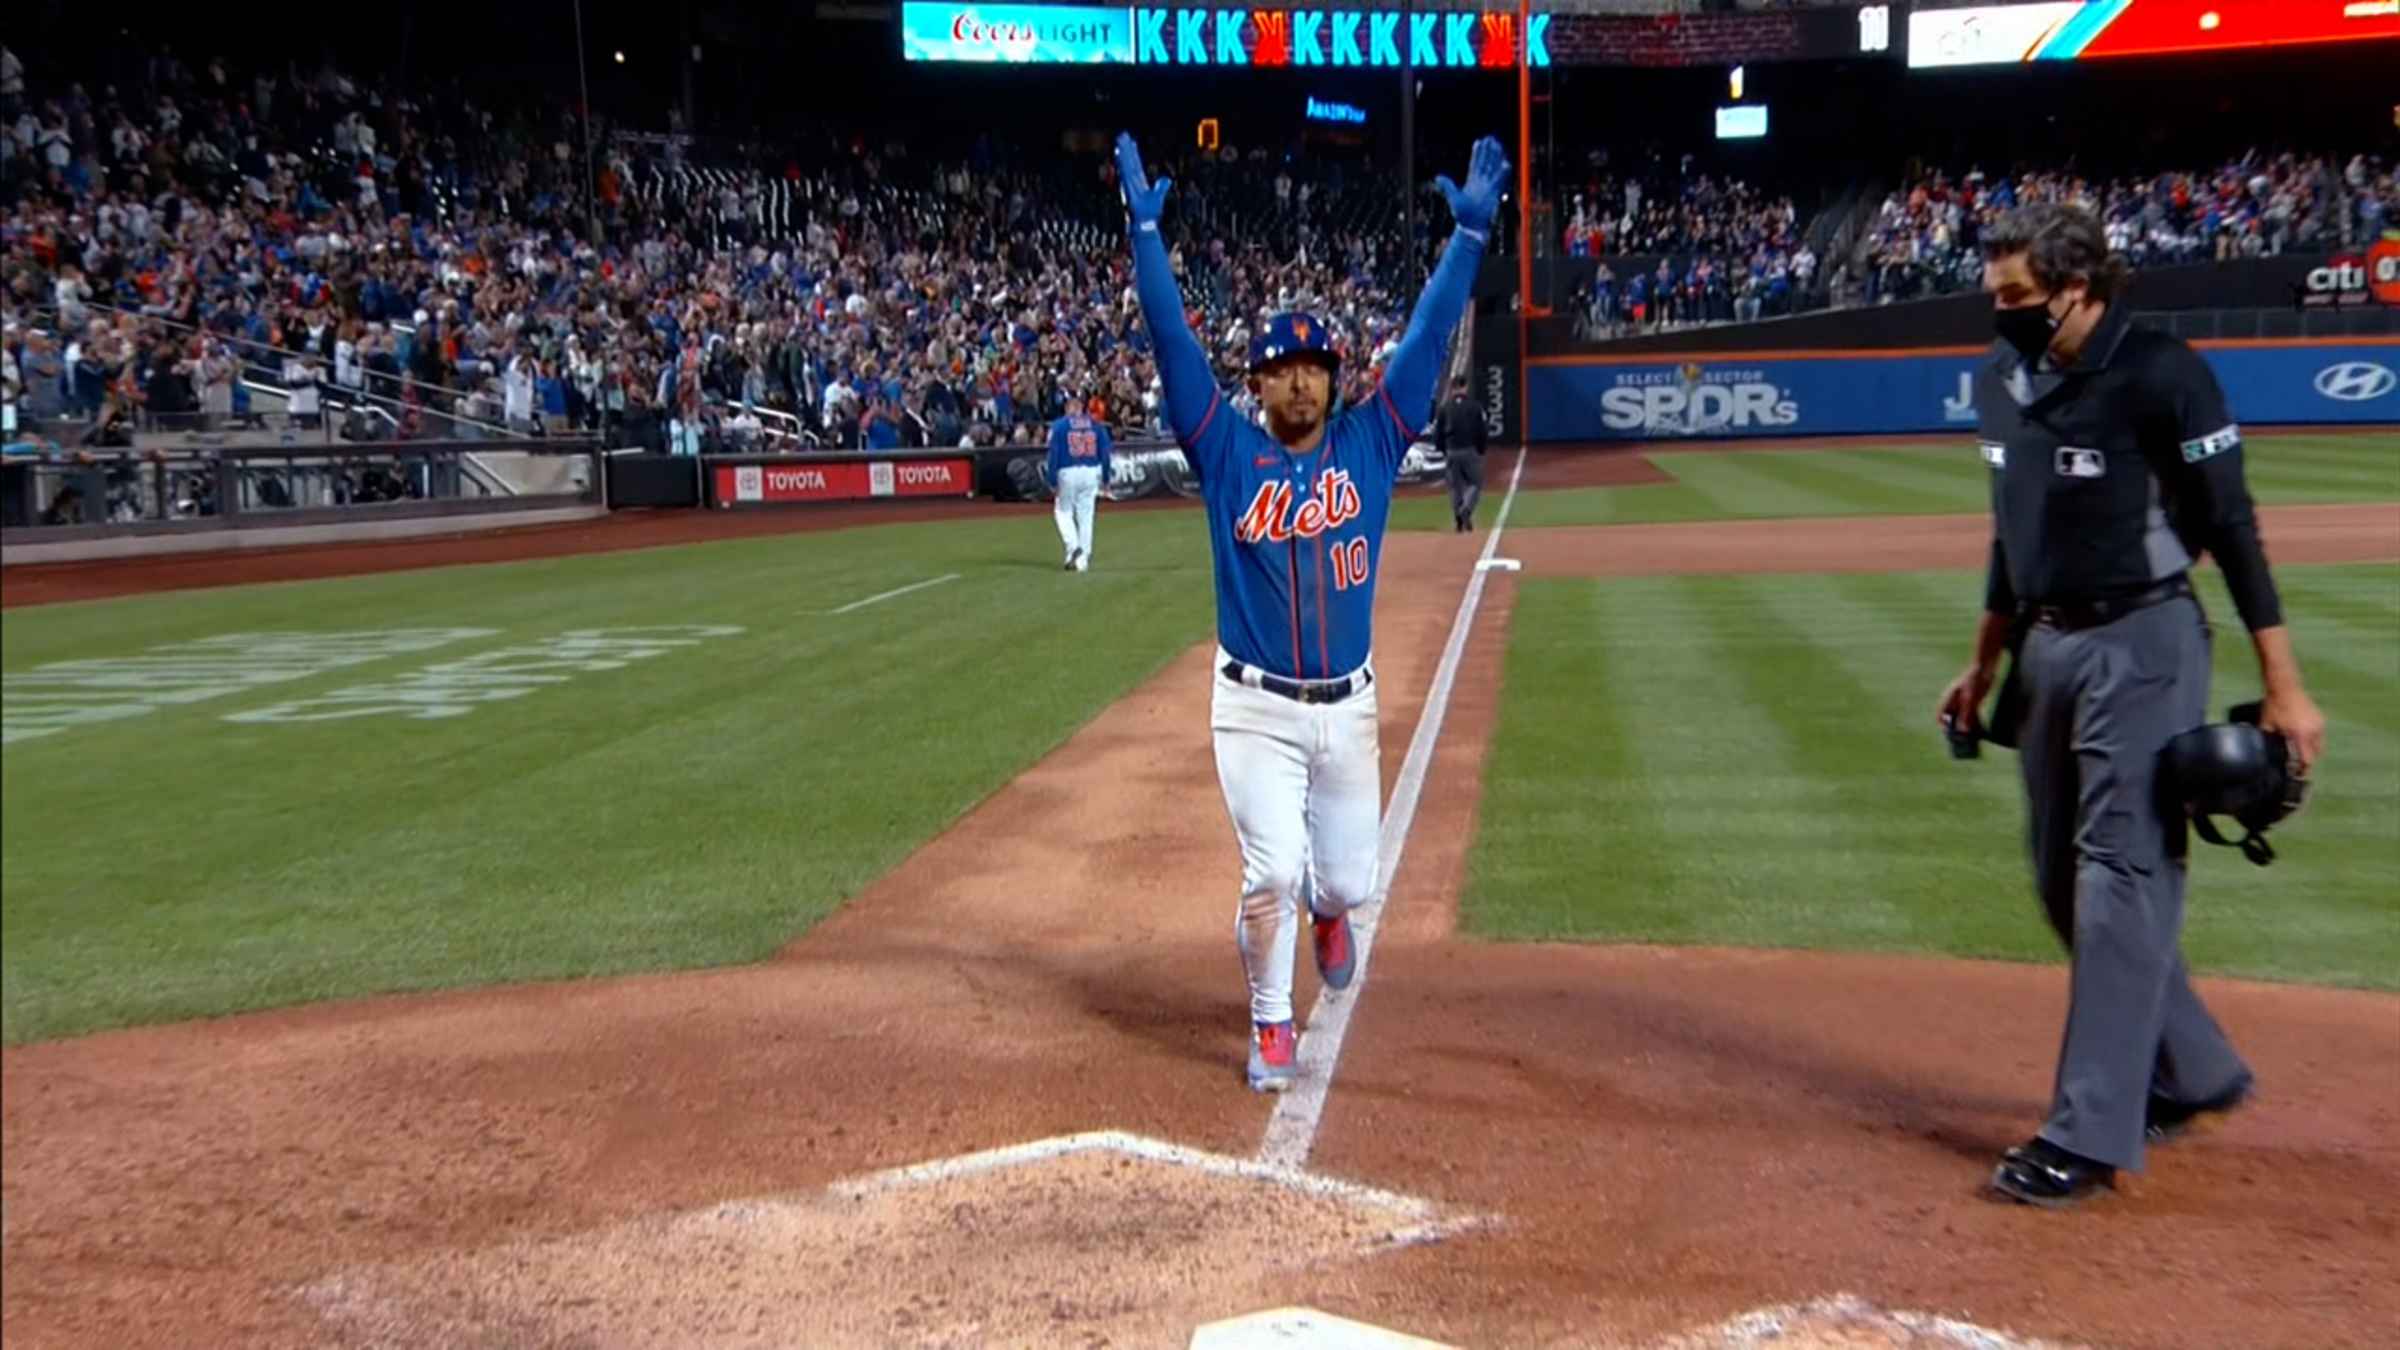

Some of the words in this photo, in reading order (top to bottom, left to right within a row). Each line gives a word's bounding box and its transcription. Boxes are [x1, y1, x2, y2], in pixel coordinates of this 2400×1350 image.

[1039, 23, 1112, 44] LIGHT
[1616, 373, 1672, 385] SELECT
[1705, 370, 1764, 384] SECTOR
[767, 472, 826, 490] TOYOTA
[898, 466, 952, 484] TOYOTA
[1235, 467, 1360, 542] Mets
[1330, 536, 1368, 591] 10
